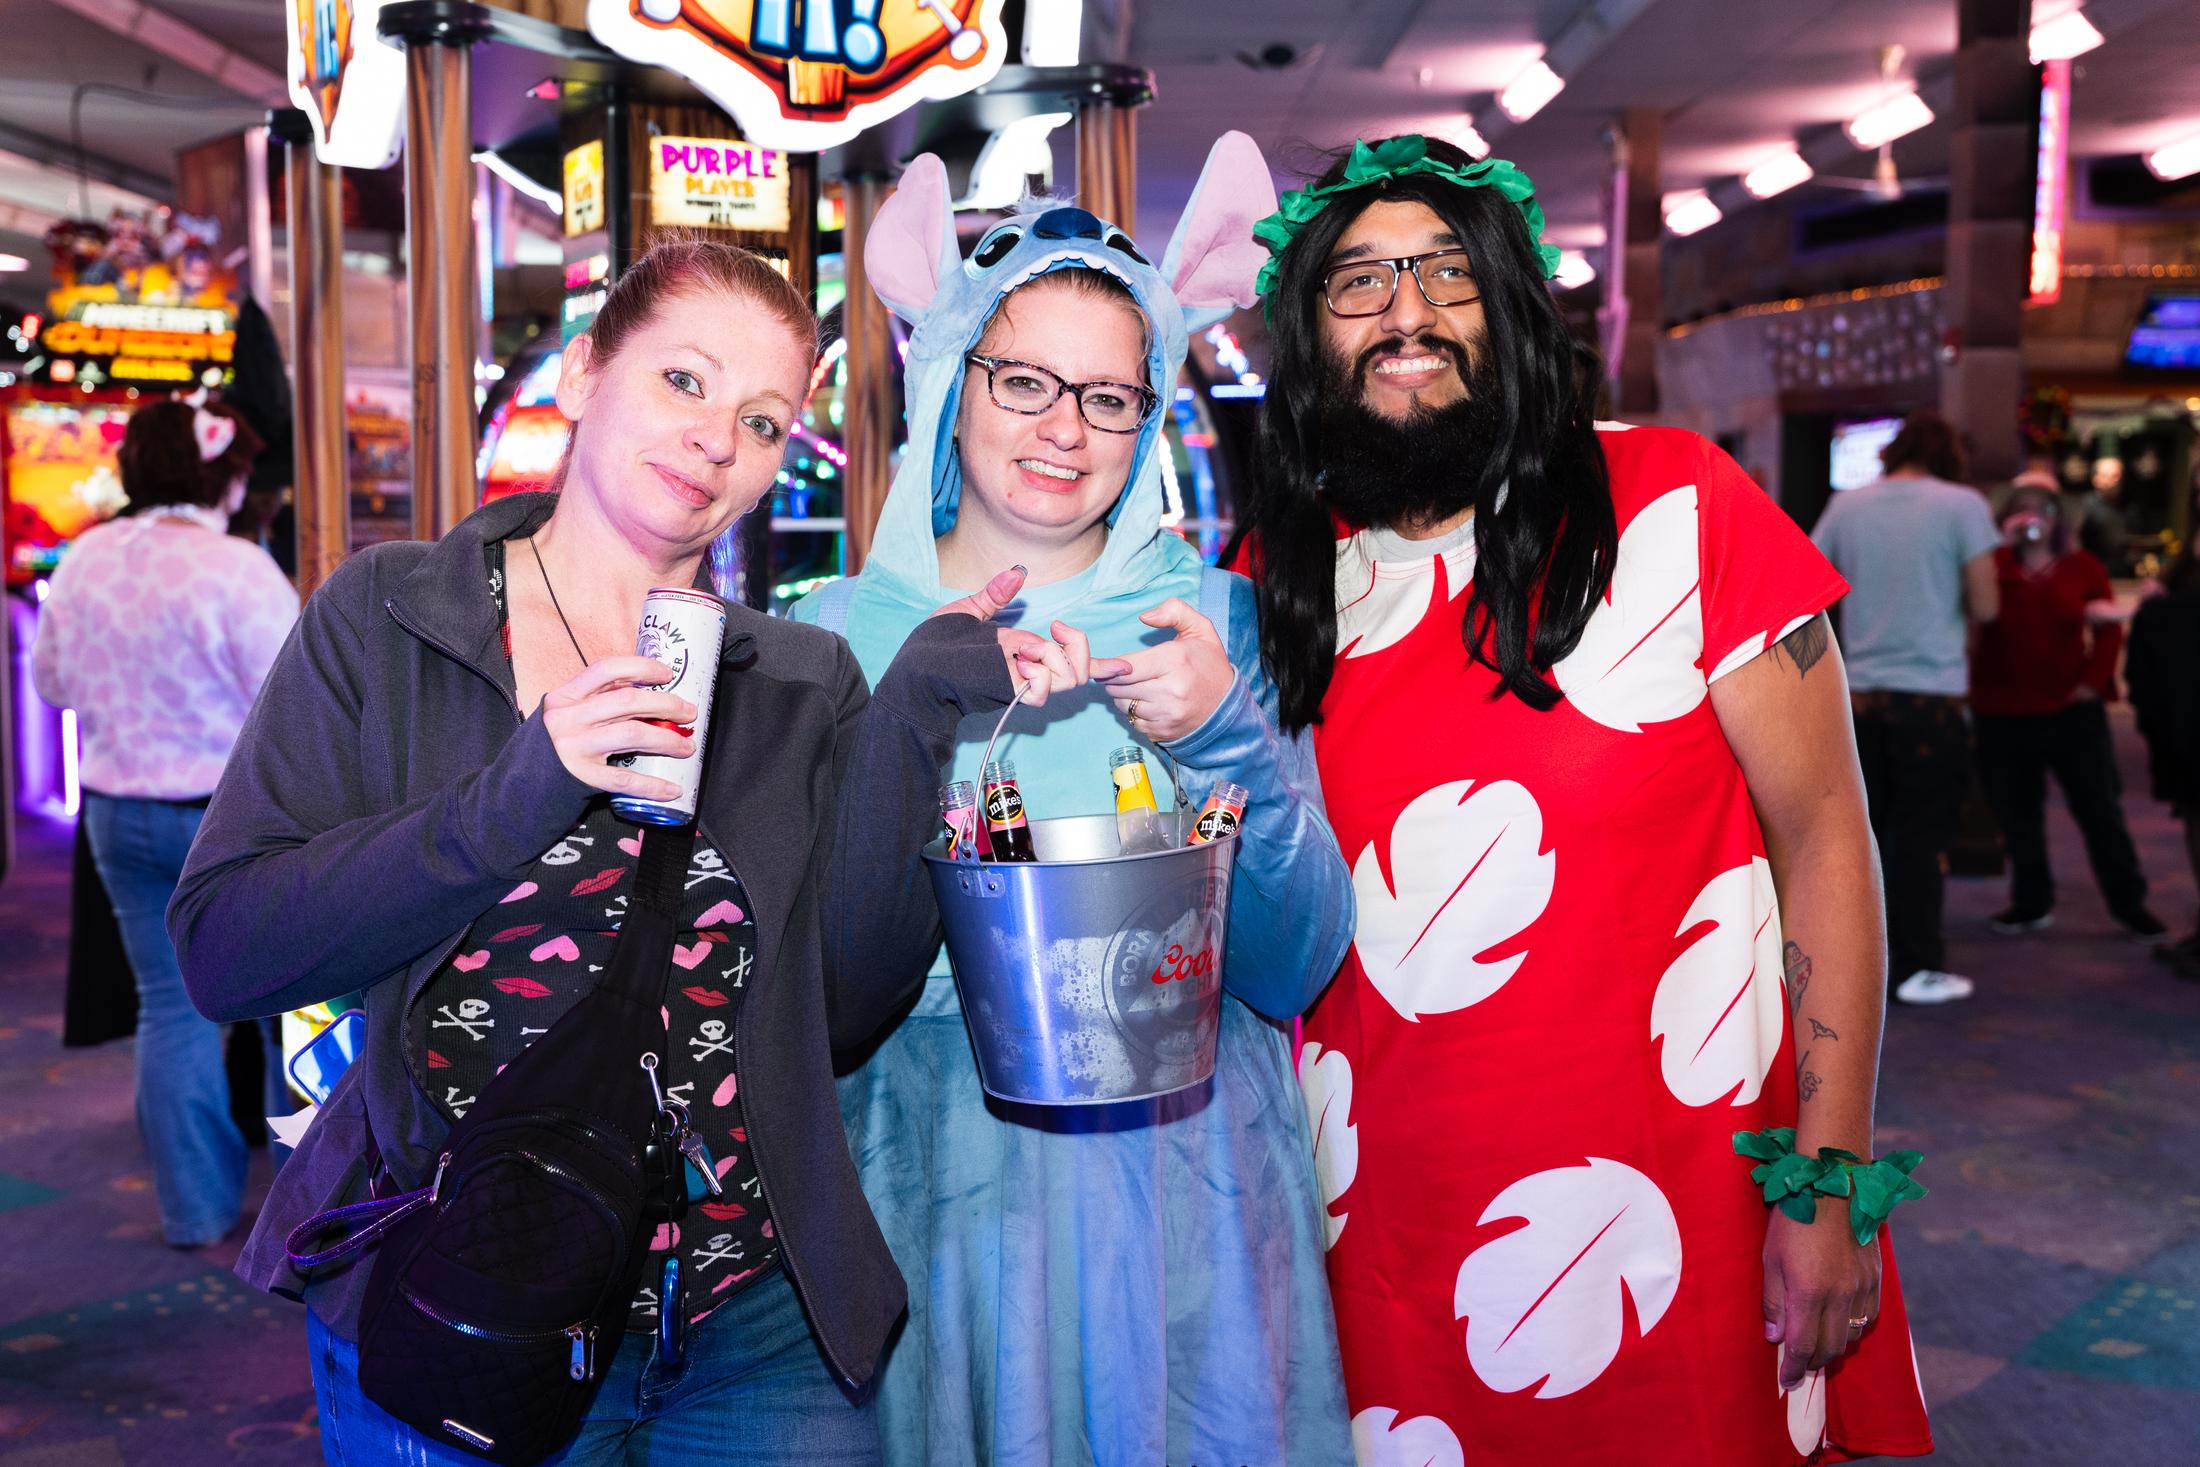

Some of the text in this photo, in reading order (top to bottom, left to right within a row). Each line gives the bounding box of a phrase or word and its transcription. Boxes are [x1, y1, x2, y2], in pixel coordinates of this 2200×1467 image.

[662, 144, 777, 178] PURPLE
[686, 177, 754, 197] PLAYER
[643, 614, 686, 644] CLAW
[988, 794, 1022, 816] mike's
[1151, 943, 1219, 984] Coo
